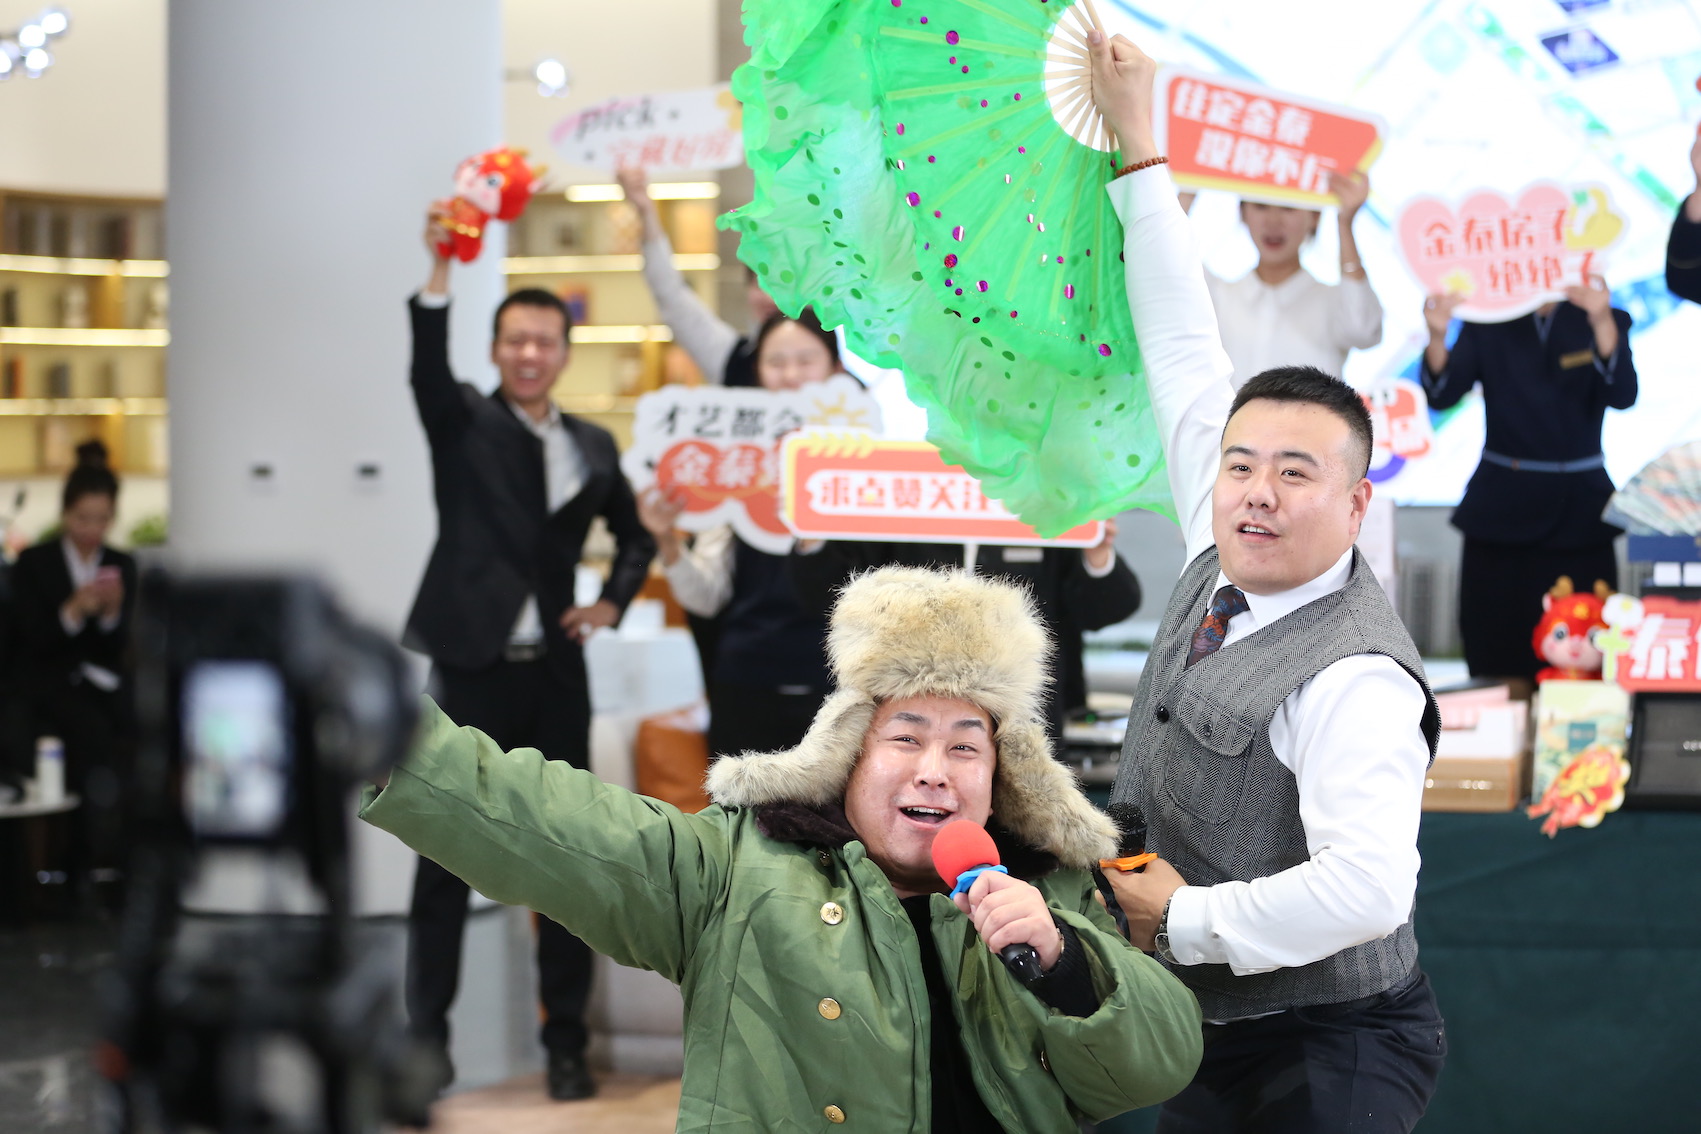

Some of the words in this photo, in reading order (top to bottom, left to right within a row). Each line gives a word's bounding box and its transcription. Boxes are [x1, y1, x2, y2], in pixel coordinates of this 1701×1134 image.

[577, 96, 654, 141] pick
[1194, 128, 1339, 196] 没你不行
[1629, 613, 1701, 681] 泰
